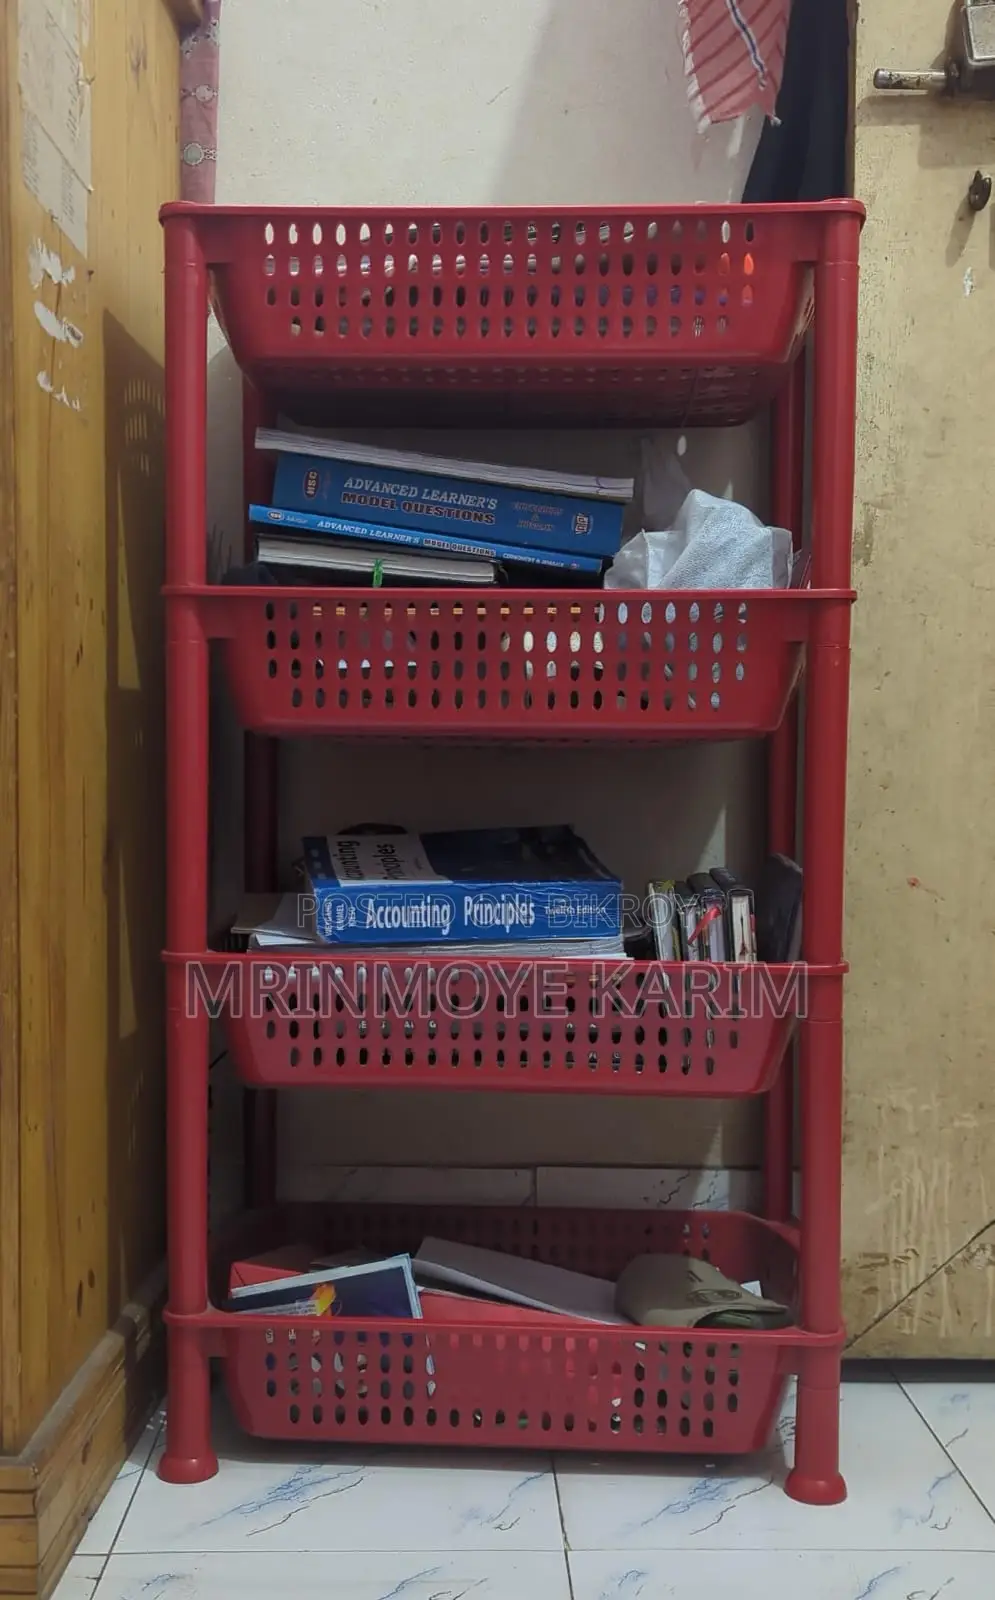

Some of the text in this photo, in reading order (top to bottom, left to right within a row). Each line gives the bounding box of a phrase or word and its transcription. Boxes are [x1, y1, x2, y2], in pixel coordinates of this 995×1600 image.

[340, 492, 399, 511] MODEL
[401, 500, 496, 525] QUESTIONS
[343, 477, 418, 498] ADVANCED
[421, 488, 498, 510] LEARNER'S
[317, 520, 497, 557] ADVANCED LEARNER'S MODEL QUESTIONS
[336, 904, 345, 931] KIMMEL
[366, 894, 535, 935] Accounting Principles
[576, 903, 605, 915] Edition
